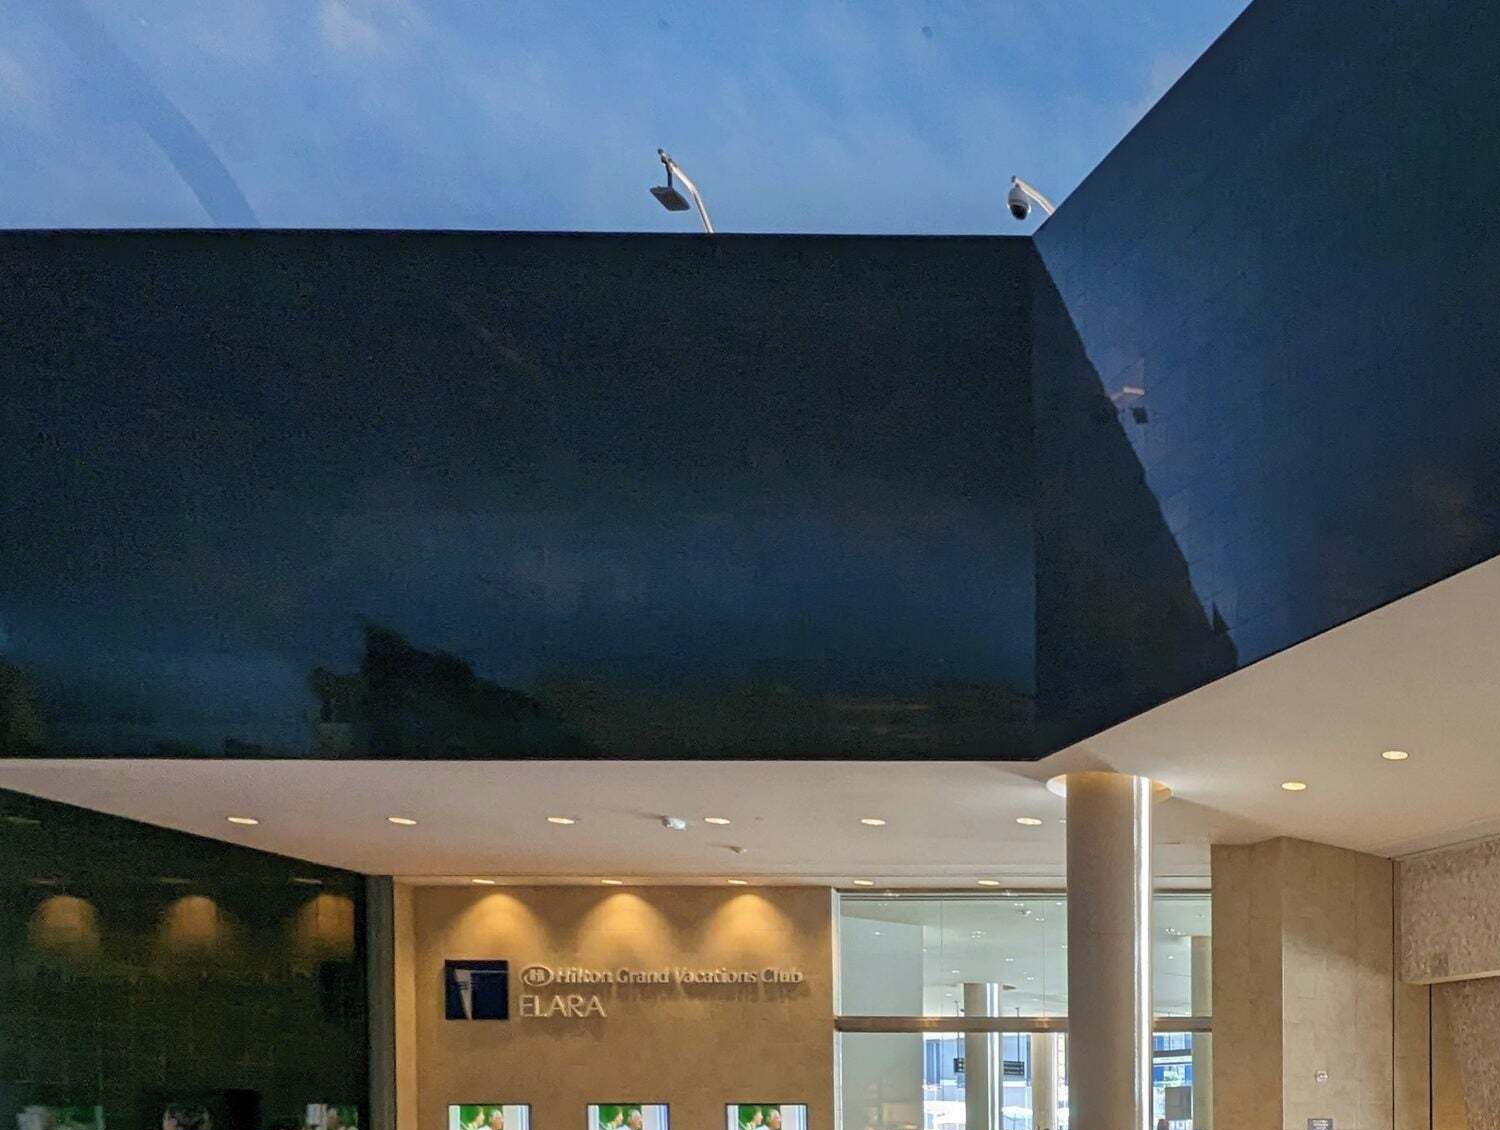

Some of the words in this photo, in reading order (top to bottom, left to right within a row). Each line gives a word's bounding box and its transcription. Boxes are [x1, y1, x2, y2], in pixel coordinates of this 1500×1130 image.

[557, 967, 613, 983] Hilton
[617, 967, 671, 983] Grand
[673, 966, 758, 983] Vacations
[761, 966, 804, 983] Club
[520, 994, 607, 1018] ELARA
